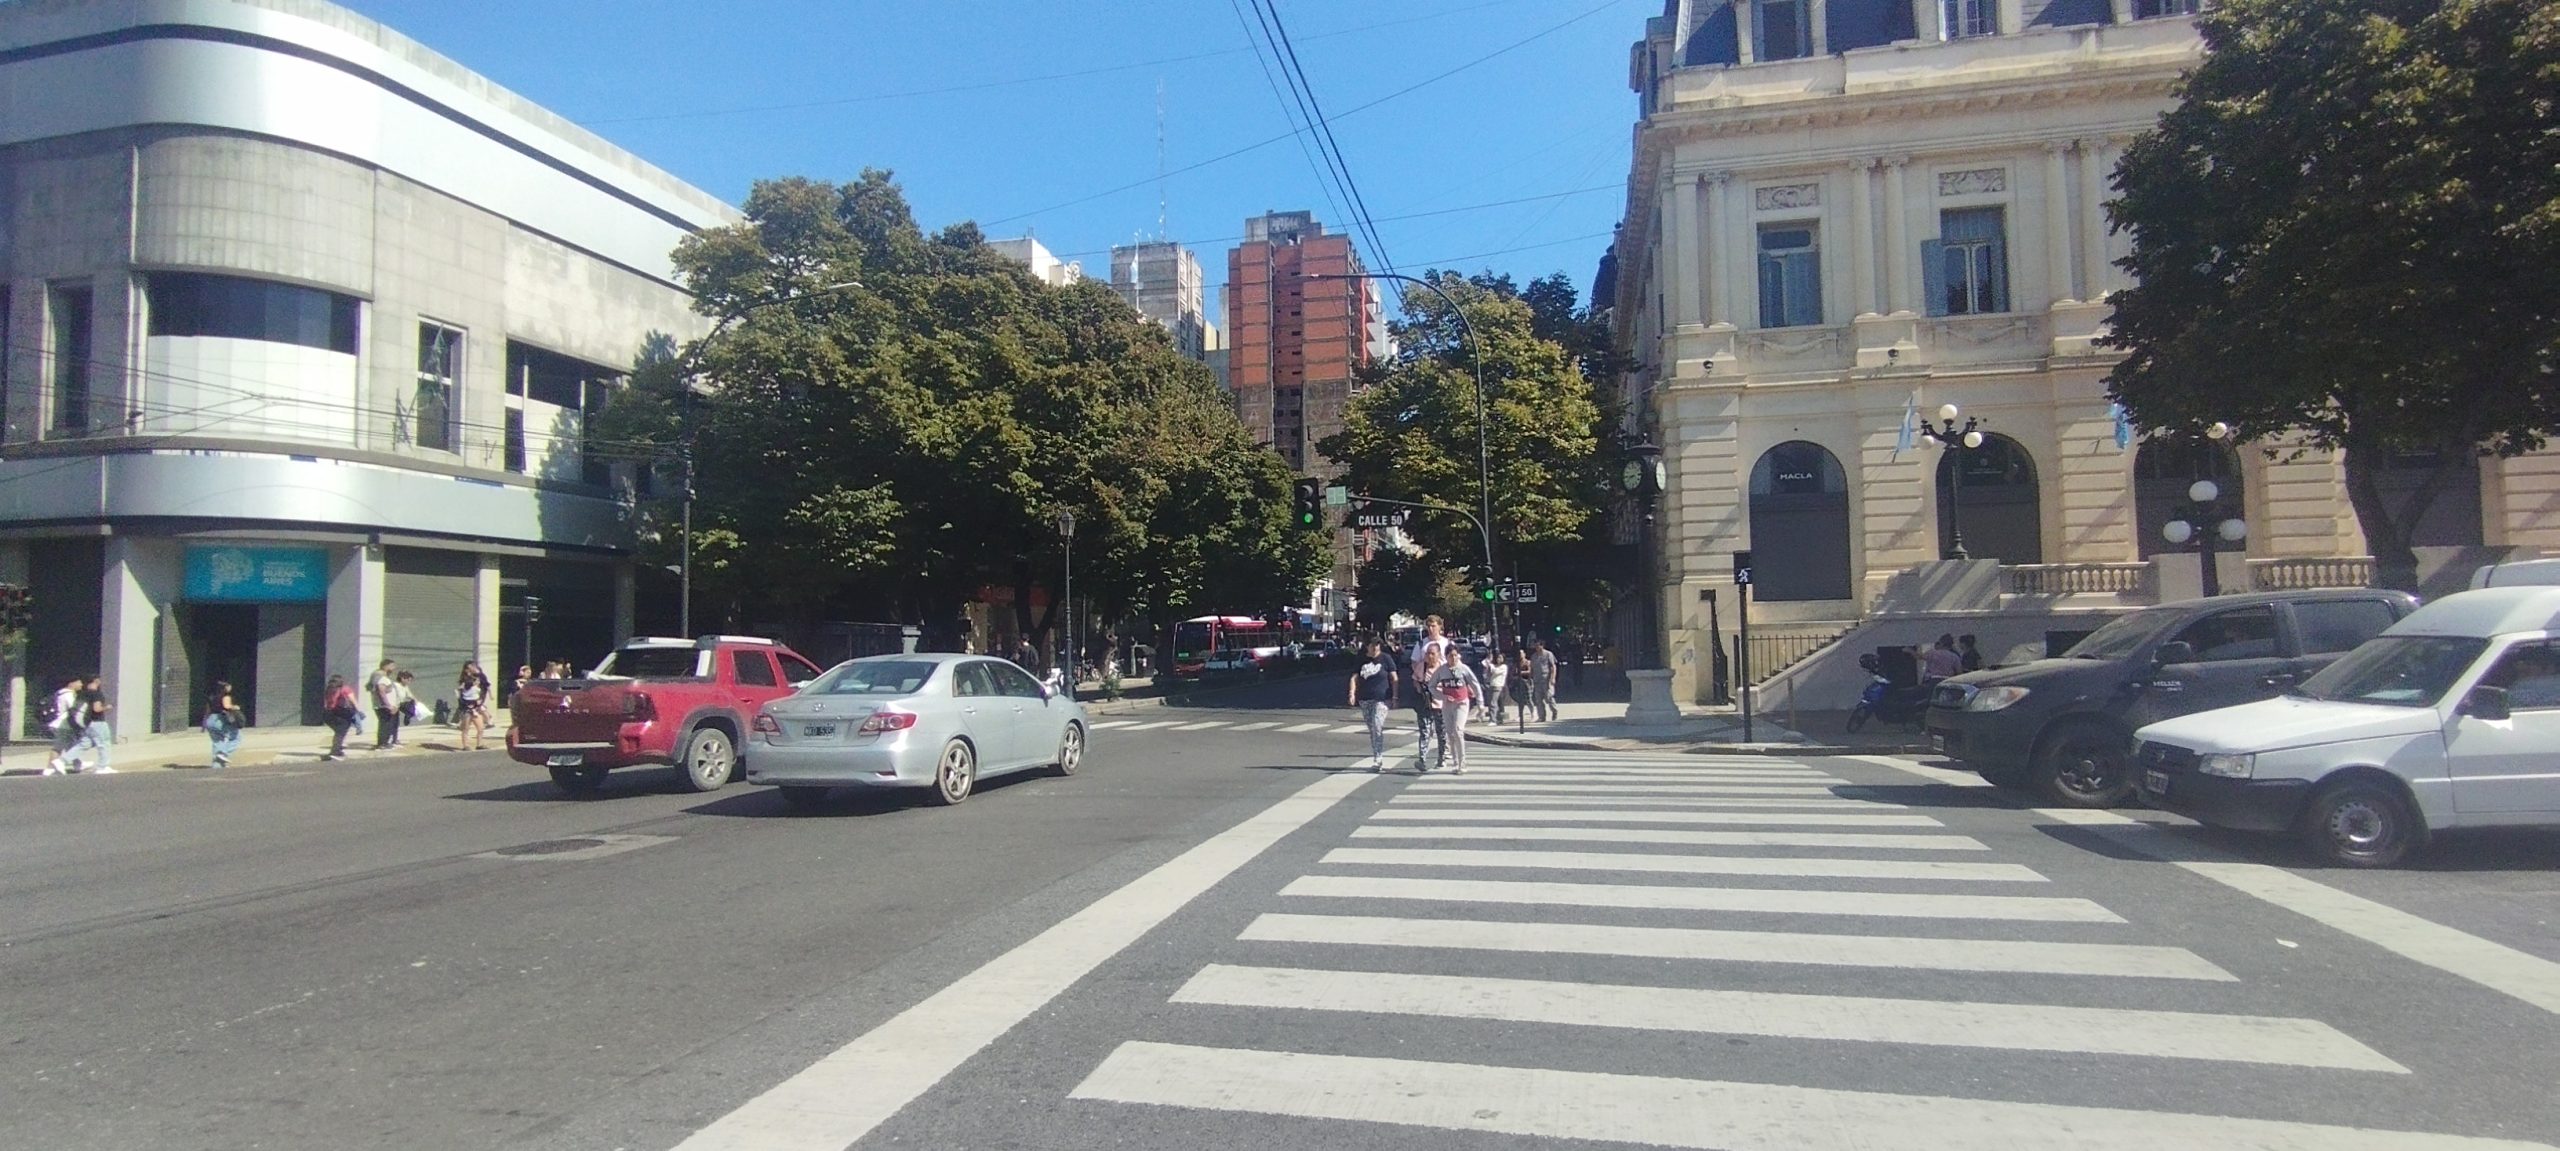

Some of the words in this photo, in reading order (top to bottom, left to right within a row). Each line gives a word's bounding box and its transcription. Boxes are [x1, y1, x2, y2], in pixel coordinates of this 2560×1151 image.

[1780, 472, 1813, 480] MACLA
[1358, 515, 1388, 526] CALLE
[1391, 515, 1403, 526] 50
[1521, 588, 1532, 596] 50
